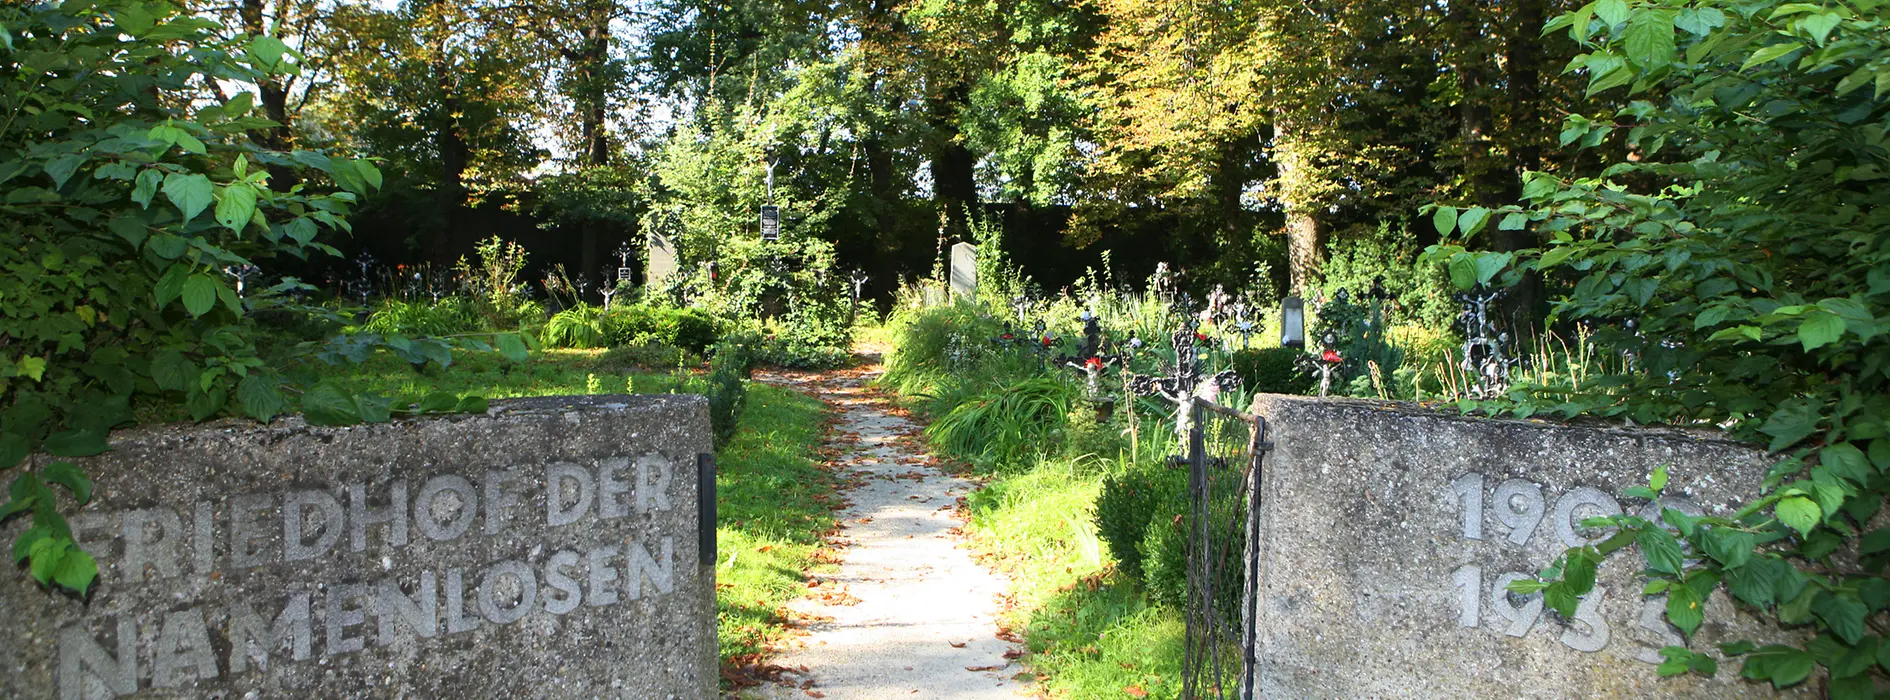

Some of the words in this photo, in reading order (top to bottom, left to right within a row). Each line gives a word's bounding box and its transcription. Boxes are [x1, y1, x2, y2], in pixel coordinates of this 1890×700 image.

[69, 468, 522, 585] FRIEDHOF
[546, 452, 674, 527] DER
[59, 536, 674, 700] NAMENLOSEN
